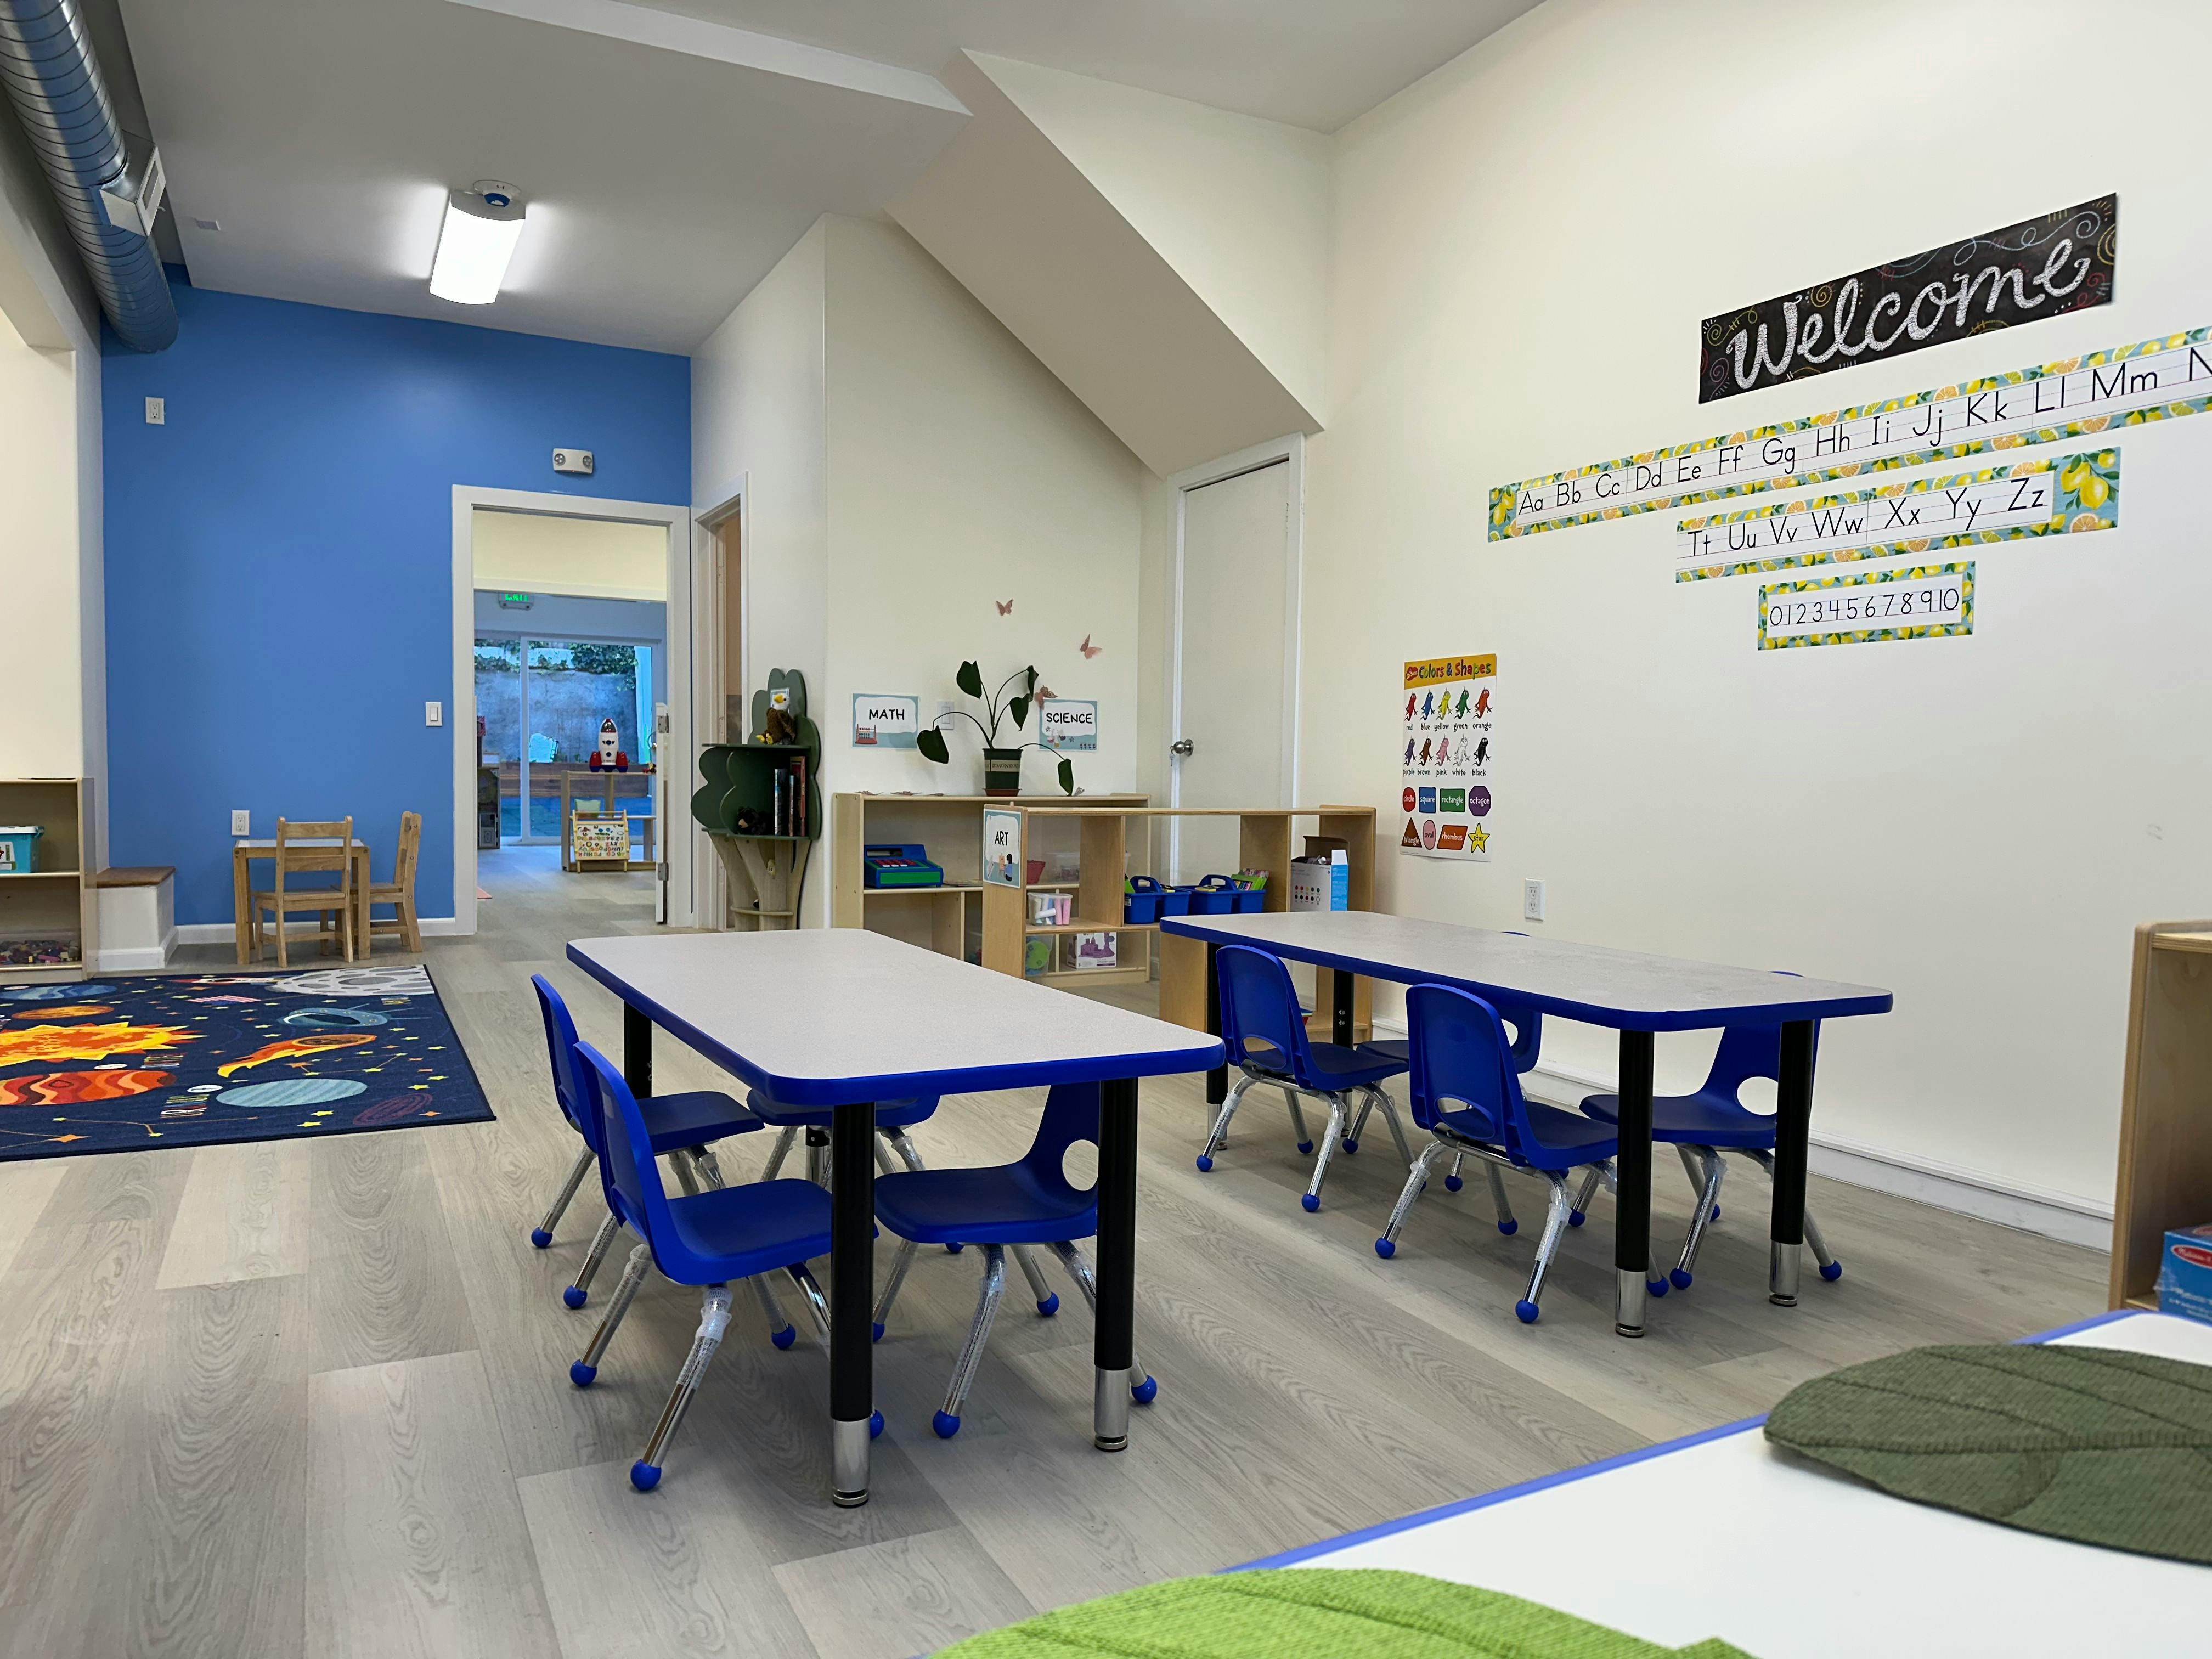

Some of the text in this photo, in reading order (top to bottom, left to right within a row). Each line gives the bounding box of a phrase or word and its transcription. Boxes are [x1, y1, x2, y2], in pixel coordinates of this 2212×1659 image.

[1726, 238, 2090, 390] Welcome
[1519, 491, 1543, 515] Aa
[1557, 481, 1581, 507] Bb
[1596, 473, 1620, 498] Cc
[1636, 462, 1662, 491] Dd
[1678, 456, 1701, 482] Ee
[1719, 445, 1743, 475] Ff
[1763, 438, 1795, 474] Gg
[1817, 424, 1850, 456] Hh
[1872, 416, 1890, 445] Ii
[1912, 405, 1943, 447] Jj
[1967, 391, 2007, 426] Kk
[2035, 376, 2065, 413] Ll
[2092, 363, 2157, 401] Mm
[1688, 477, 2044, 556] Tt Uu Vv Ww Xx Yy Zz
[1419, 663, 1444, 679] Colors
[1446, 663, 1453, 676] &
[1455, 659, 1491, 680] Shapes
[868, 709, 905, 721] MATH
[1046, 712, 1093, 724] SCIENCE
[1434, 723, 1449, 731] yellow
[1454, 723, 1468, 732] green
[1472, 722, 1492, 731] orange
[1403, 768, 1415, 777] purple
[1436, 768, 1447, 777] pink
[1452, 768, 1466, 776] white
[1420, 797, 1435, 805] square
[1441, 795, 1464, 806] rectangle
[1469, 797, 1490, 807] octagon
[995, 831, 1009, 846] ART
[1403, 837, 1420, 846] triangle
[1442, 831, 1463, 841] rhombus
[1473, 834, 1484, 842] star
